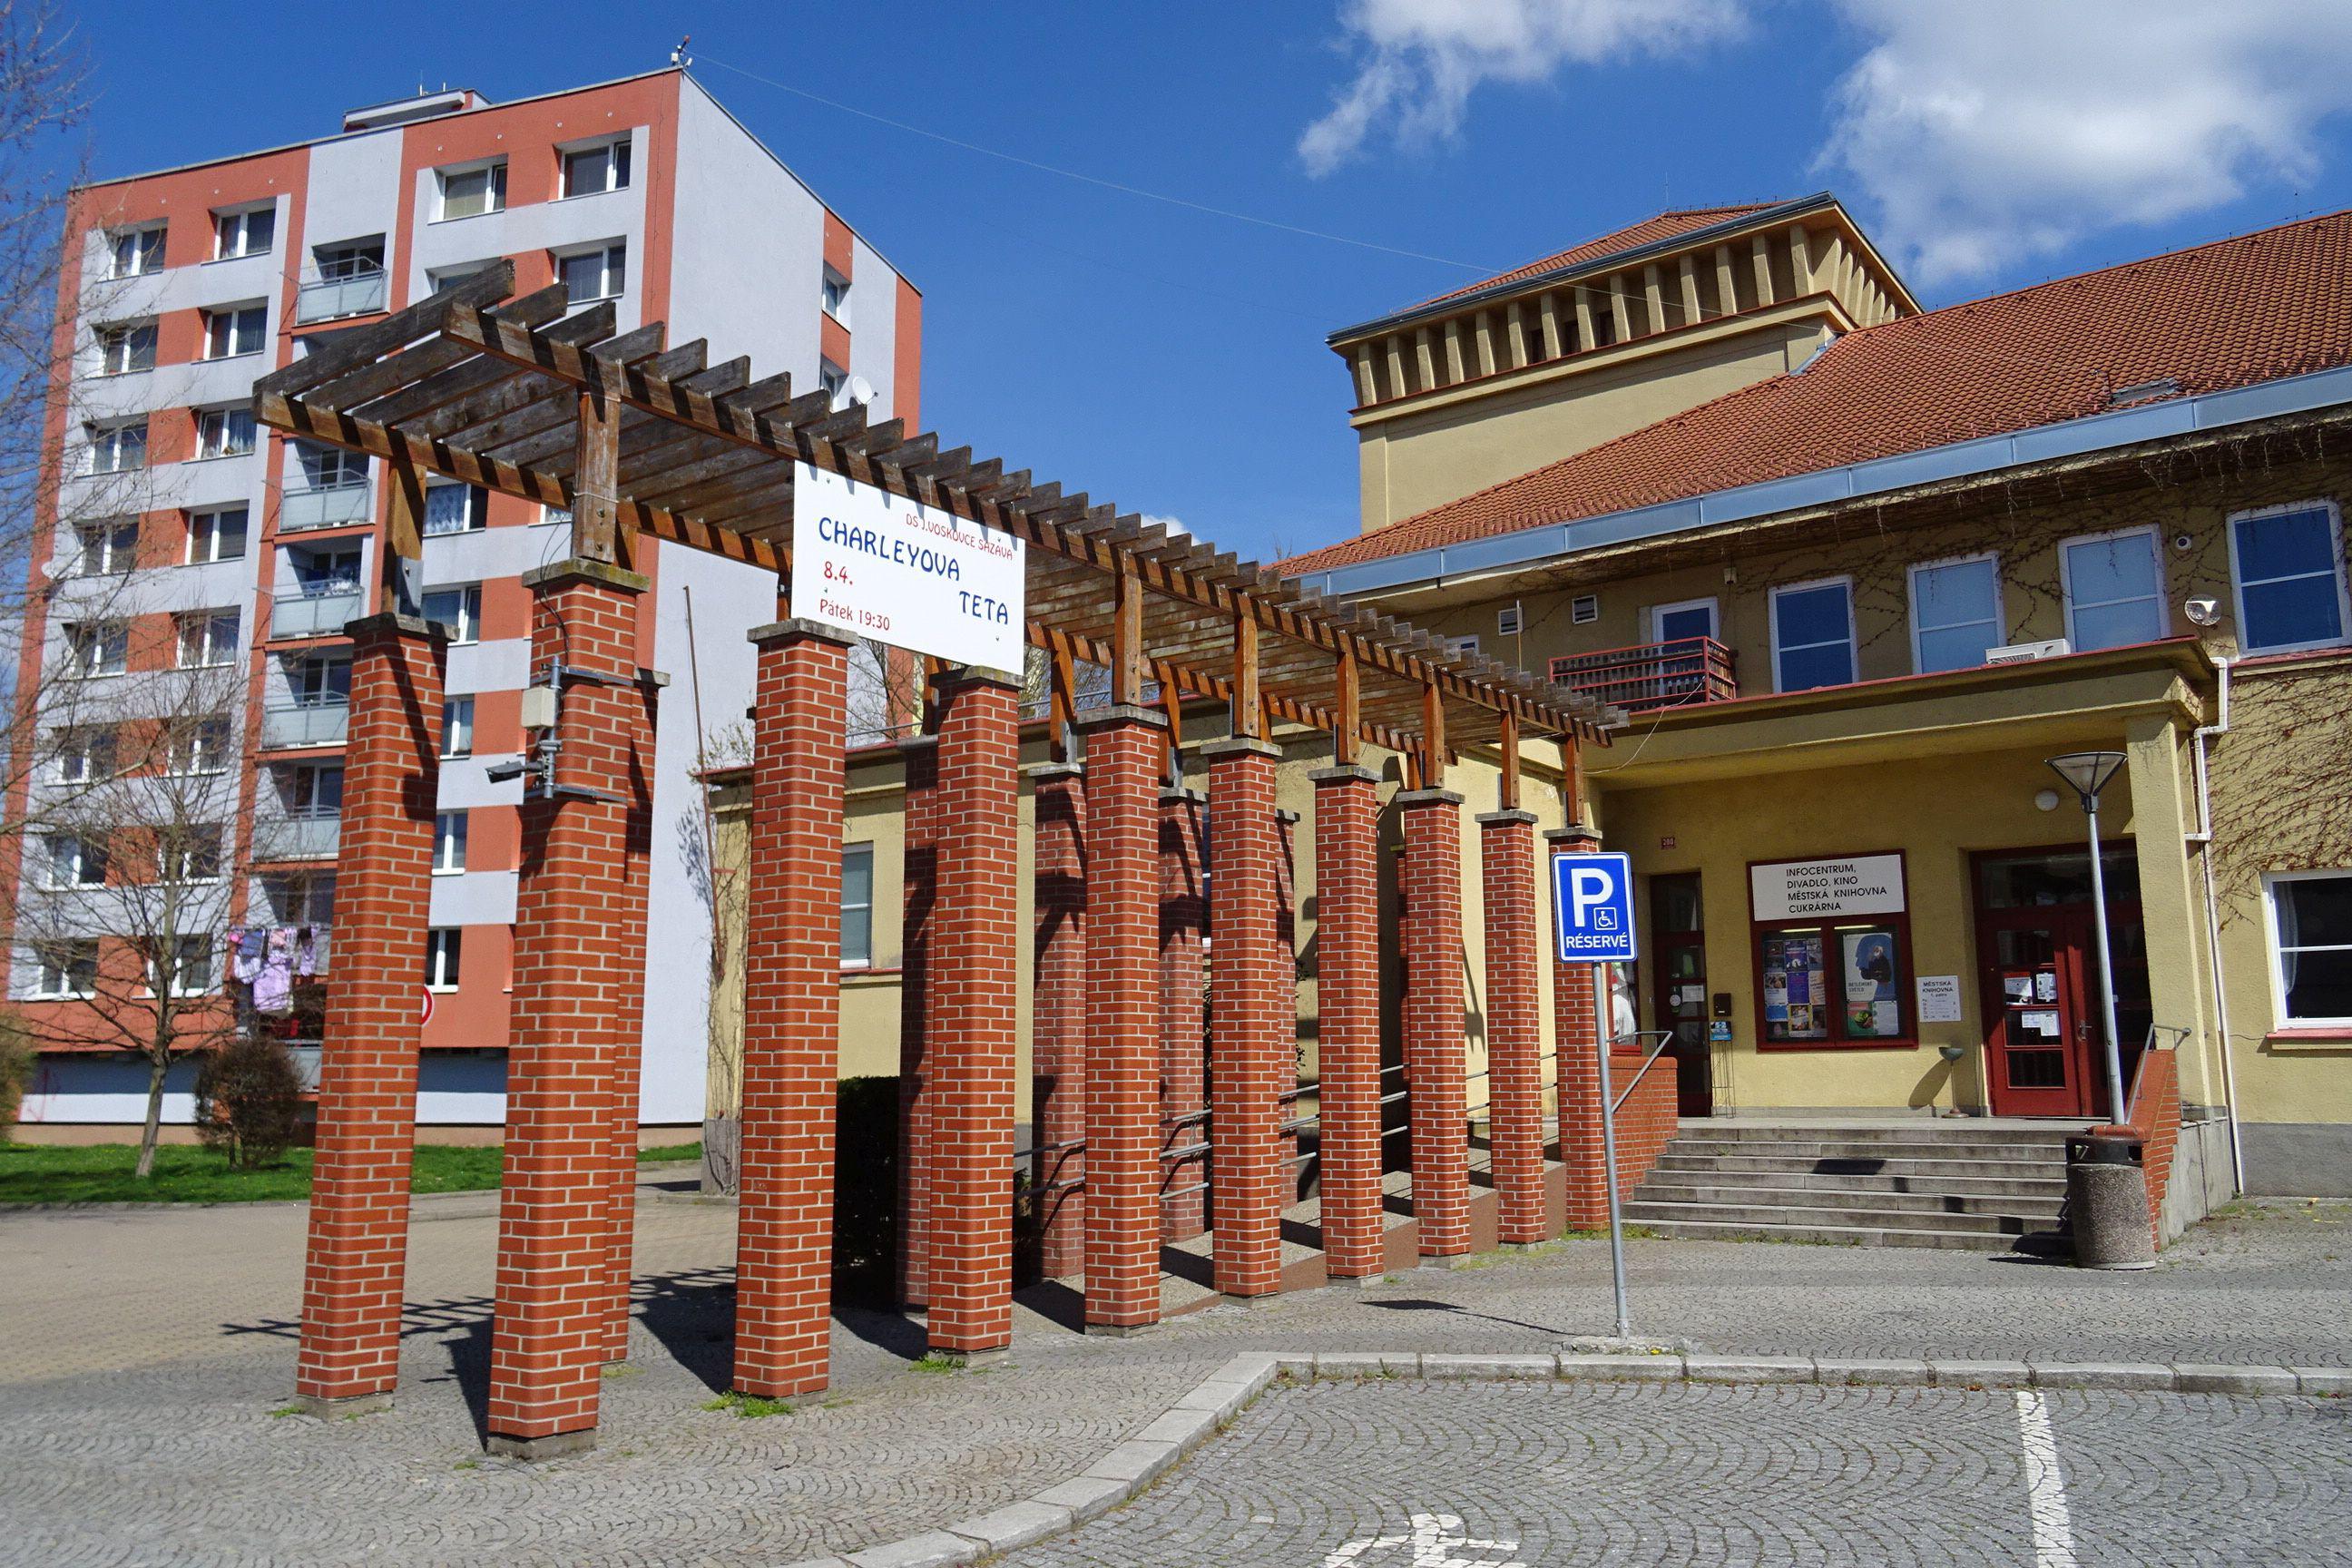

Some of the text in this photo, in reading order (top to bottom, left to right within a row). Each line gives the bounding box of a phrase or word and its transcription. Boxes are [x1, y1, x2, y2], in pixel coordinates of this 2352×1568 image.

[906, 513, 918, 527] DS
[818, 516, 960, 582] CHARLEYOVA
[823, 561, 854, 585] 8.4.
[819, 598, 890, 632] Pátek 19:30
[959, 591, 1009, 625] TETA
[1787, 865, 1857, 877] INFOCENTRUM,
[1834, 877, 1858, 886] KINO
[1571, 867, 1613, 927] P
[1788, 887, 1887, 900] MĚSTSKÁ KNIHOVNA
[1789, 902, 1841, 913] CUKRÁRNA
[1566, 932, 1628, 948] RÉSERVÉ
